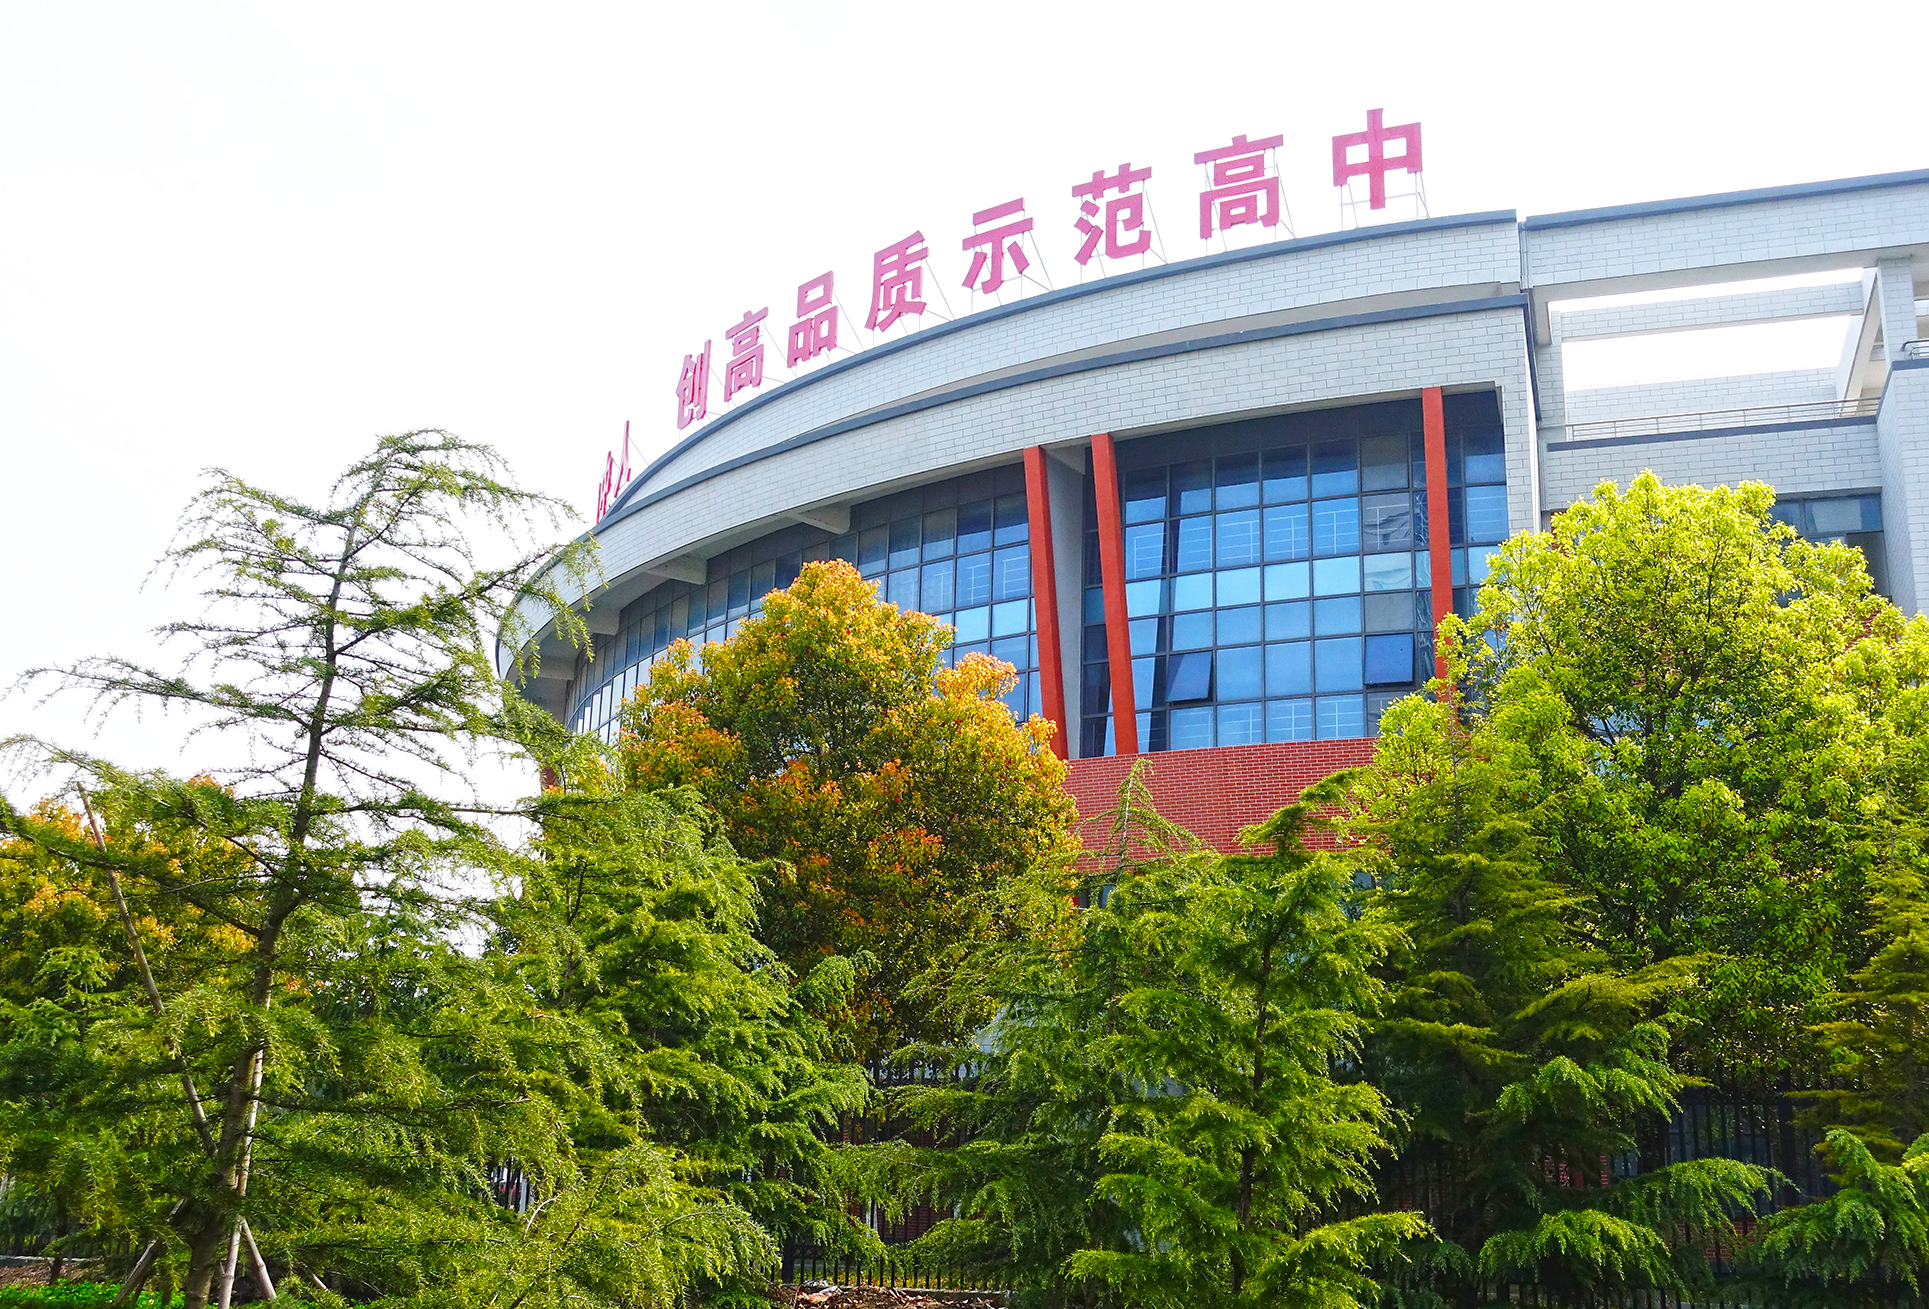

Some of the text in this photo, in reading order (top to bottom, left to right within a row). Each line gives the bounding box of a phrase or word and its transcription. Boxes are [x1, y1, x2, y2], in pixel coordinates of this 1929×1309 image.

[677, 108, 1423, 430] 创高品质示范高中
